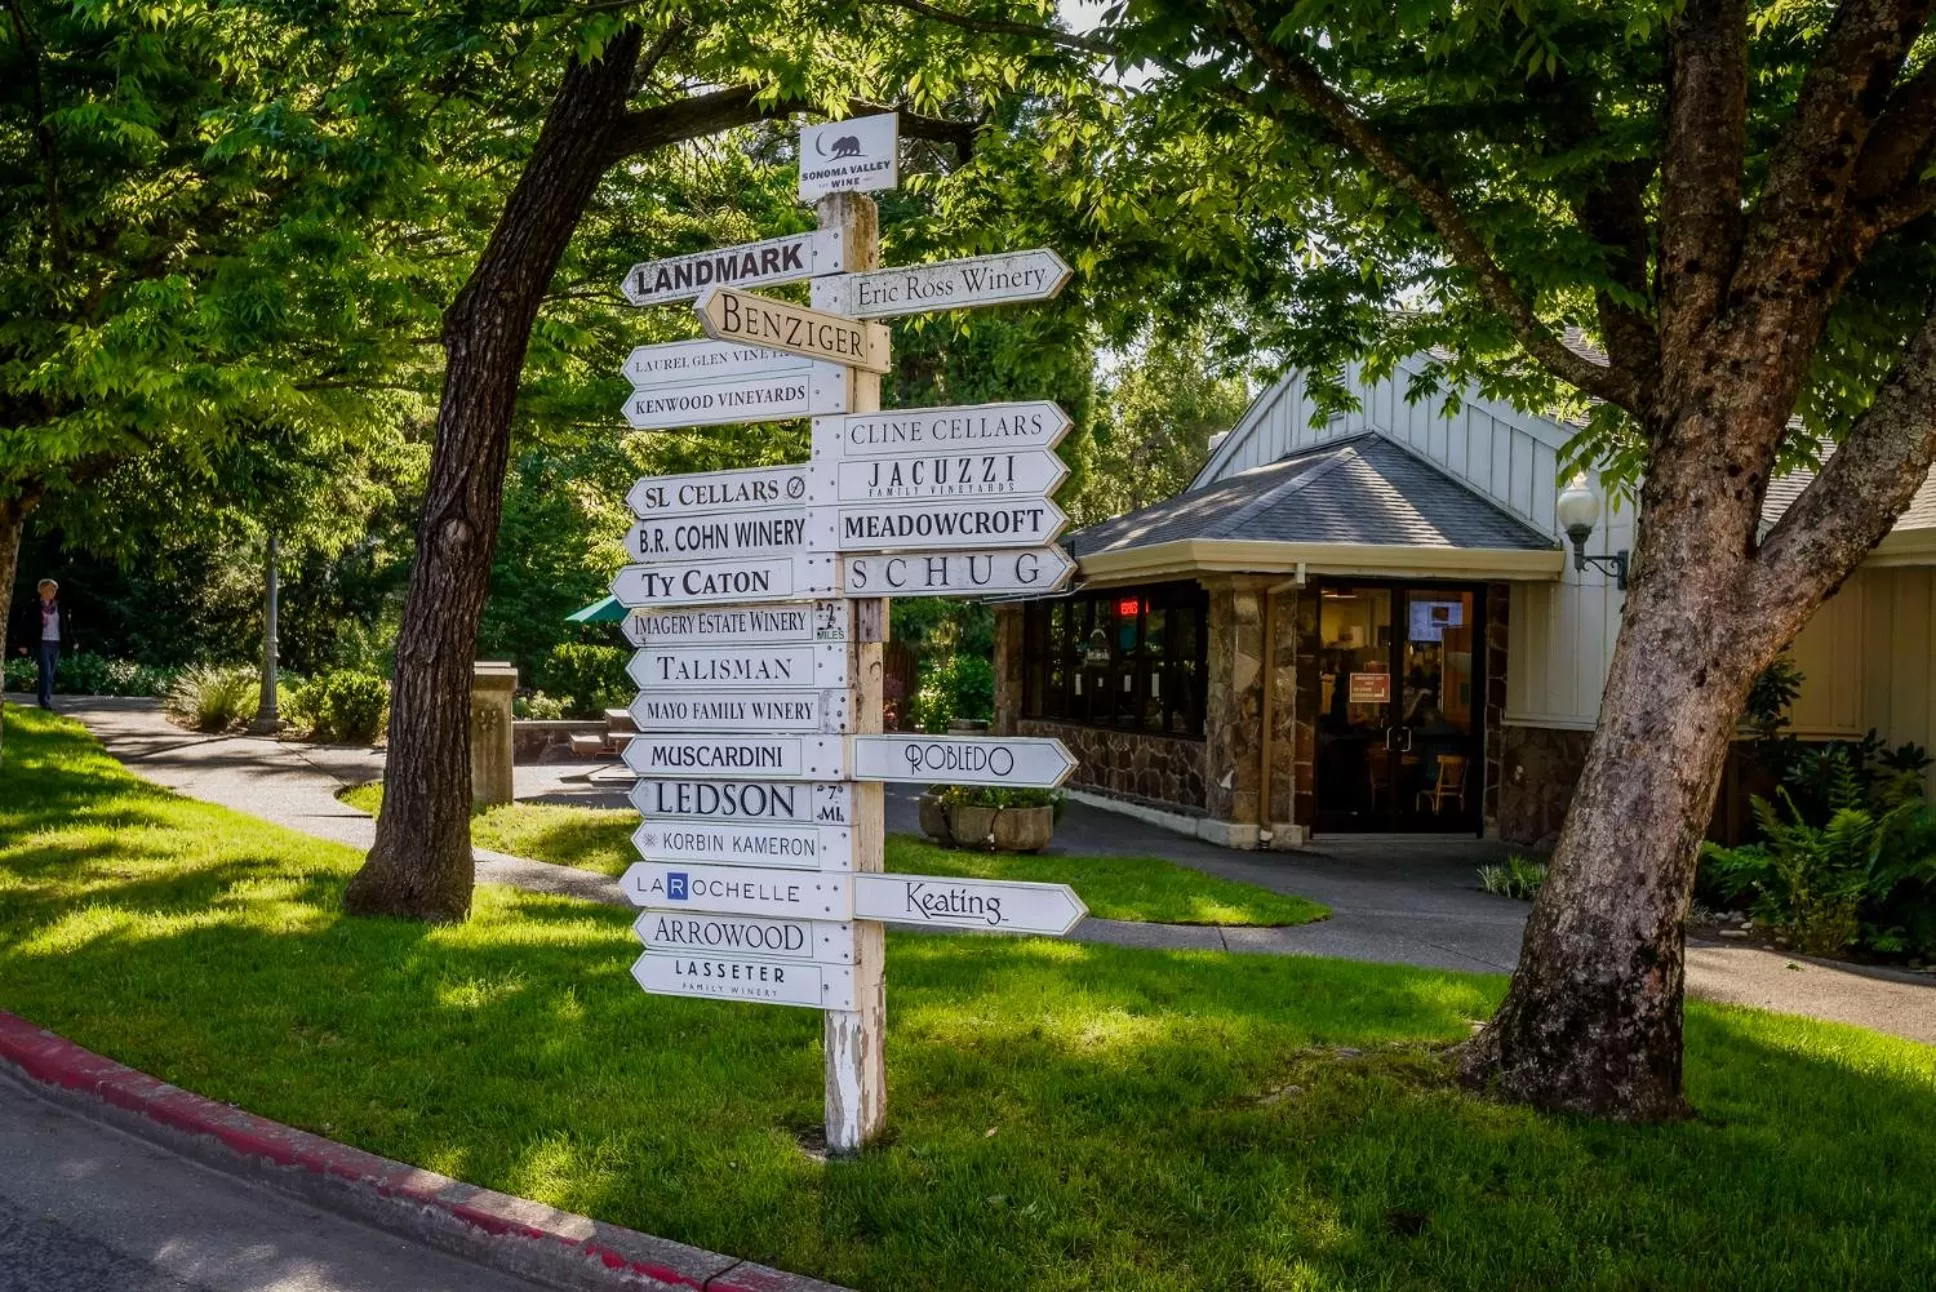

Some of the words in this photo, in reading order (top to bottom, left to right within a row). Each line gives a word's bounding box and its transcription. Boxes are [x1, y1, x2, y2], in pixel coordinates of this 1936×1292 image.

[802, 167, 847, 181] SONOMA
[850, 160, 891, 174] VALLEY
[831, 177, 860, 188] WINE
[638, 243, 803, 296] LANDMARK
[858, 282, 899, 306] Eric
[906, 276, 954, 301] Ross
[961, 267, 1045, 293] Winery
[721, 292, 864, 358] BENZIGER
[635, 356, 690, 373] LAUREL
[692, 352, 728, 368] GLEN
[635, 393, 714, 415] KENWOOD
[717, 385, 806, 407] VINEYARDS
[851, 421, 922, 445] CLINE
[932, 414, 1043, 440] CELLARS
[868, 455, 1015, 488] JACUZZI
[645, 487, 670, 509] SL
[678, 479, 779, 506] CELLARS
[869, 486, 919, 498] FAMILY
[930, 482, 1015, 495] VINEYARDS
[639, 528, 669, 553] B.R.
[675, 523, 729, 551] COHN
[734, 518, 806, 548] WINERY
[845, 509, 1043, 539] MEADOWCROFT
[641, 572, 675, 597] TY
[682, 569, 771, 595] CATON
[635, 614, 695, 635] IMAGERY
[698, 613, 747, 634] ESTATE
[749, 610, 806, 632] WINERY
[656, 656, 793, 681] TALISMAN
[647, 702, 687, 720] MAYO
[693, 702, 746, 720] FAMILY
[752, 702, 814, 720] WINERY
[651, 745, 783, 767] MUSCARDINI
[905, 744, 1014, 777] ROBLEDO
[655, 782, 796, 818] LEDSON
[663, 832, 724, 852] KORBIN
[732, 835, 815, 857] KAMERON
[906, 882, 1002, 925] Keating
[654, 916, 804, 950] ARROWOOD
[675, 959, 785, 983] LASSETER
[682, 982, 723, 993] FAMILY
[731, 986, 777, 998] WINERY
